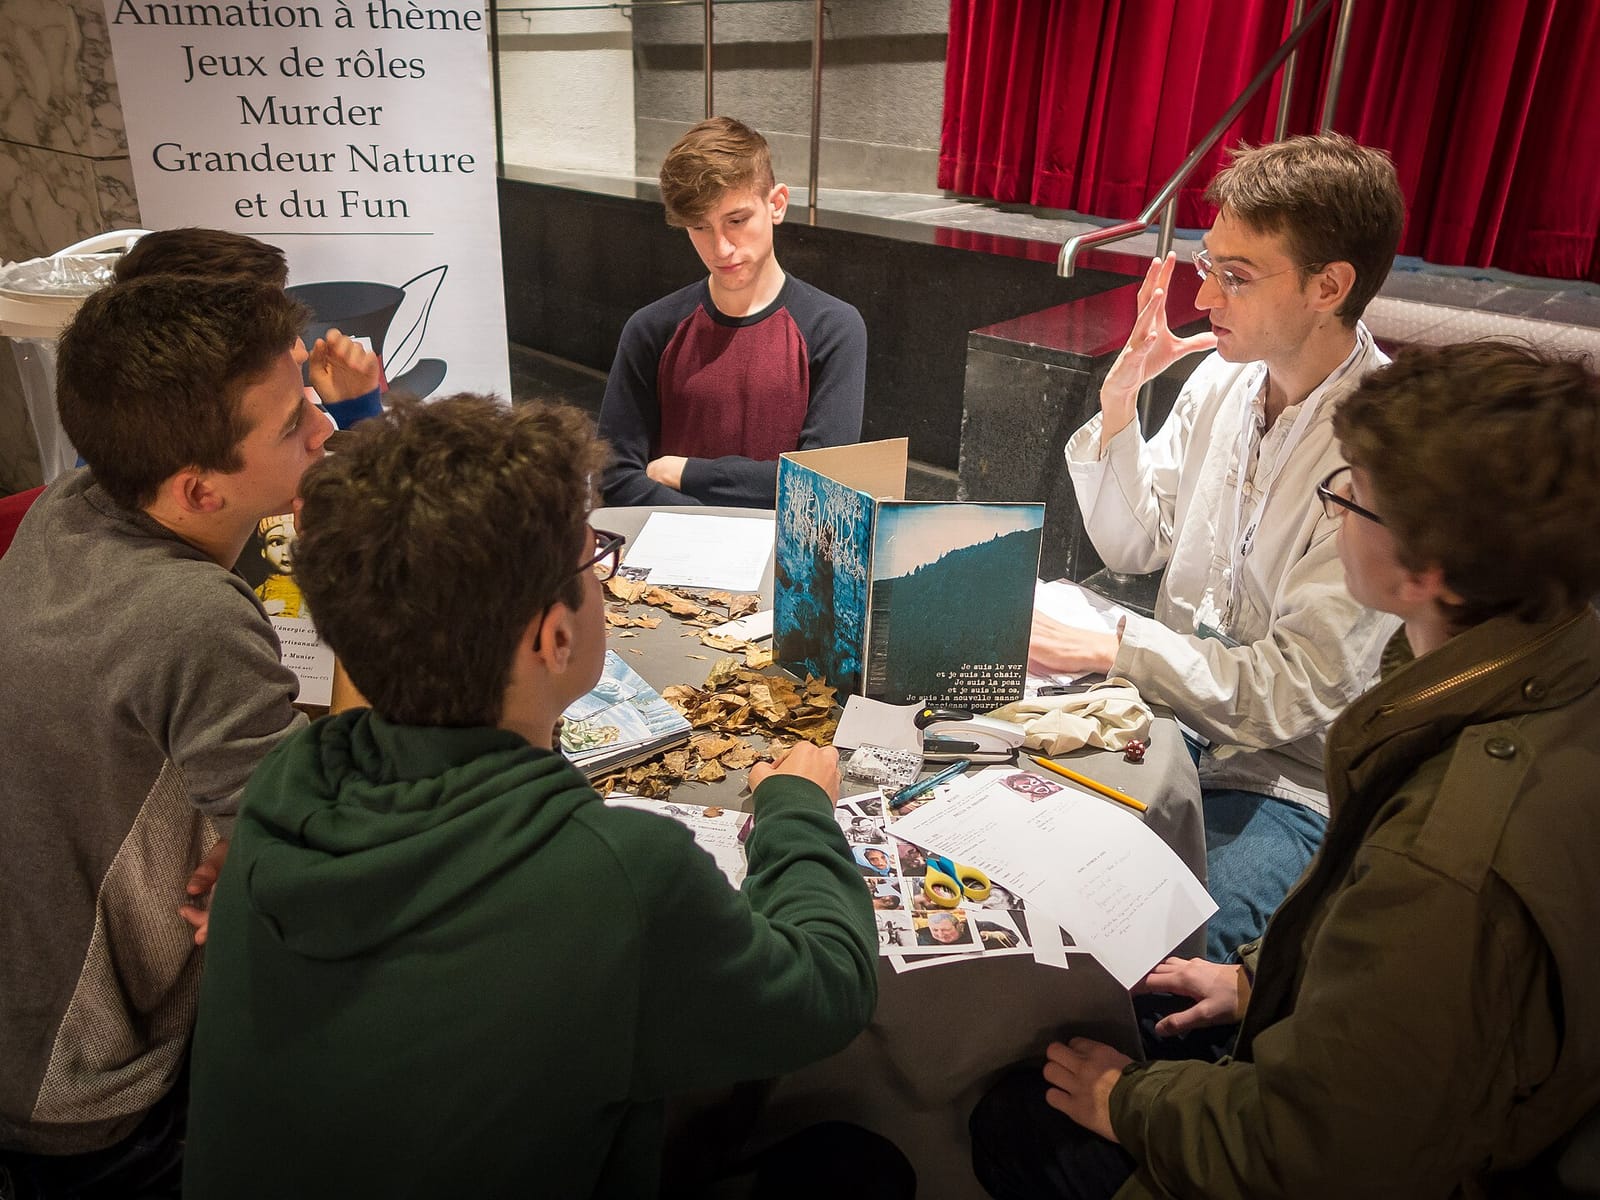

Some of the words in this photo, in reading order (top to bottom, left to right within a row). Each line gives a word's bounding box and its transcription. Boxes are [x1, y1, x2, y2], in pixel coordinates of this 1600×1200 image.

[111, 0, 324, 29] Animation
[334, 1, 356, 29] à
[366, 0, 483, 32] thème
[181, 45, 268, 83] Jeux
[279, 47, 325, 78] de
[336, 48, 426, 79] rôles
[236, 95, 383, 127] Murder
[151, 142, 336, 173] Grandeur
[346, 144, 476, 174] Nature
[234, 195, 268, 218] et
[279, 190, 326, 218] du
[338, 190, 410, 218] Fun
[948, 671, 957, 679] je
[959, 671, 978, 679] suis
[981, 671, 991, 679] la
[960, 663, 971, 671] Je
[973, 663, 992, 671] suis
[994, 663, 1005, 671] le
[1007, 663, 1023, 671] ver
[959, 687, 968, 695] je
[988, 679, 999, 687] la
